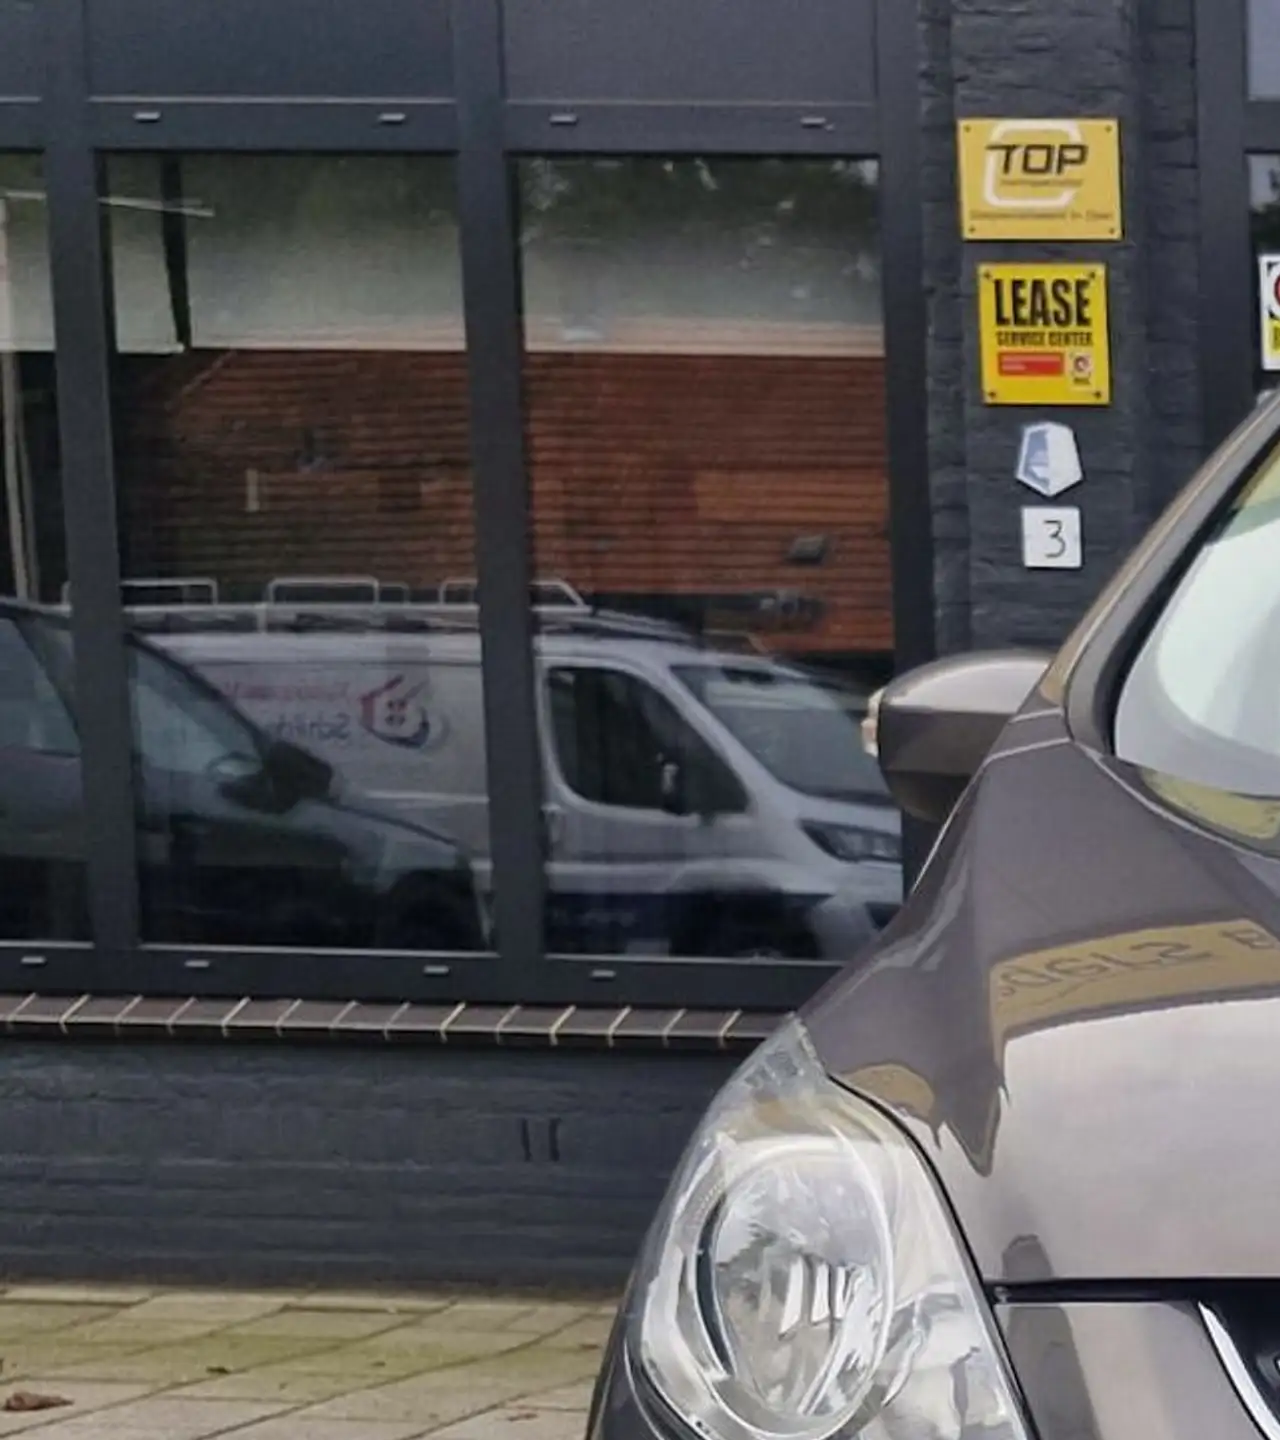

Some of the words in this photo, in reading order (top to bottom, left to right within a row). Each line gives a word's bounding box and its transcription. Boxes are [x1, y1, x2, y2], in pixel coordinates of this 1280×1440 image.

[984, 144, 1089, 174] TOP
[994, 279, 1092, 326] LEASE
[1043, 519, 1066, 559] 3
